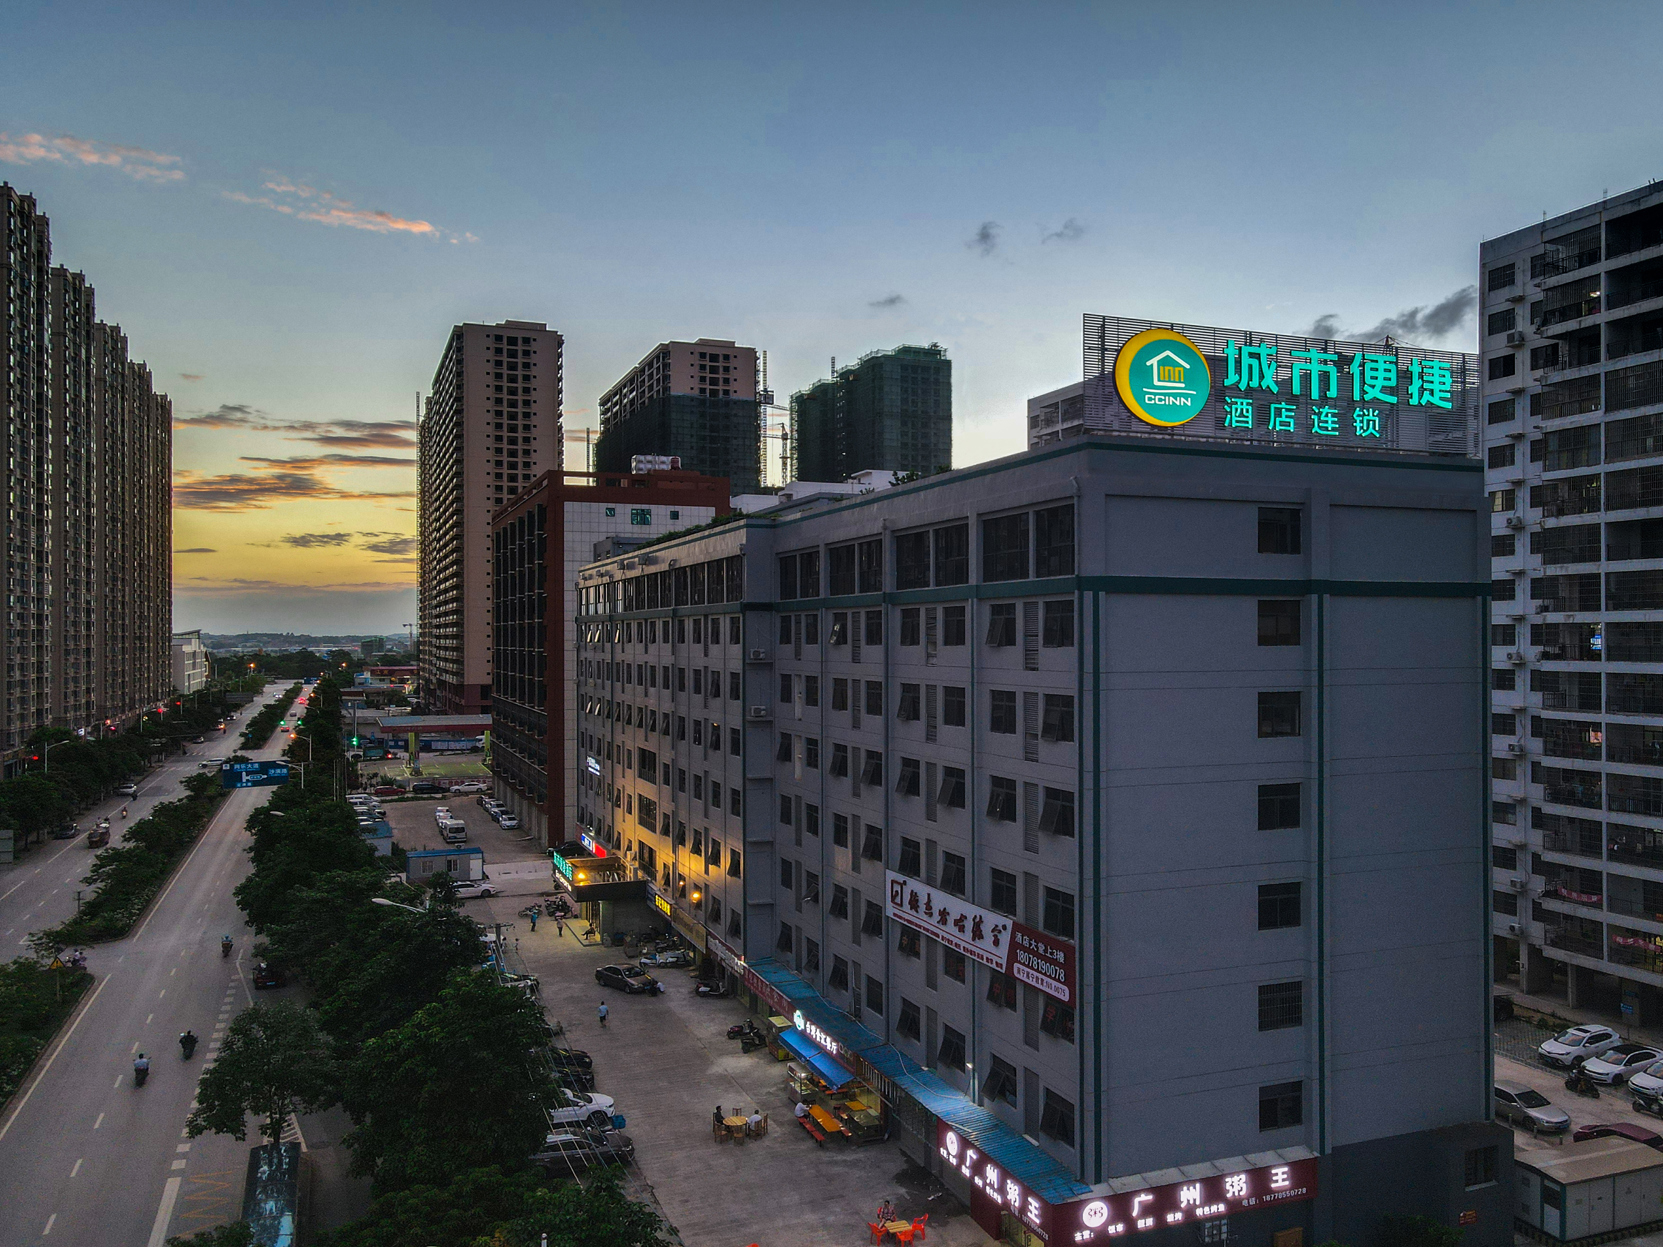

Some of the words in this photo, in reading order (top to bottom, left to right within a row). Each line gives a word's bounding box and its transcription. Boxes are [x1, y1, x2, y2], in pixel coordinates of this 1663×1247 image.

[1223, 339, 1453, 409] 城市便捷
[1145, 394, 1191, 407] CCINN
[1223, 397, 1381, 438] 酒店连锁
[1016, 949, 1065, 982] 18078190078
[966, 1149, 1040, 1224] 广州粥王
[1132, 1167, 1290, 1217] 广州粥王
